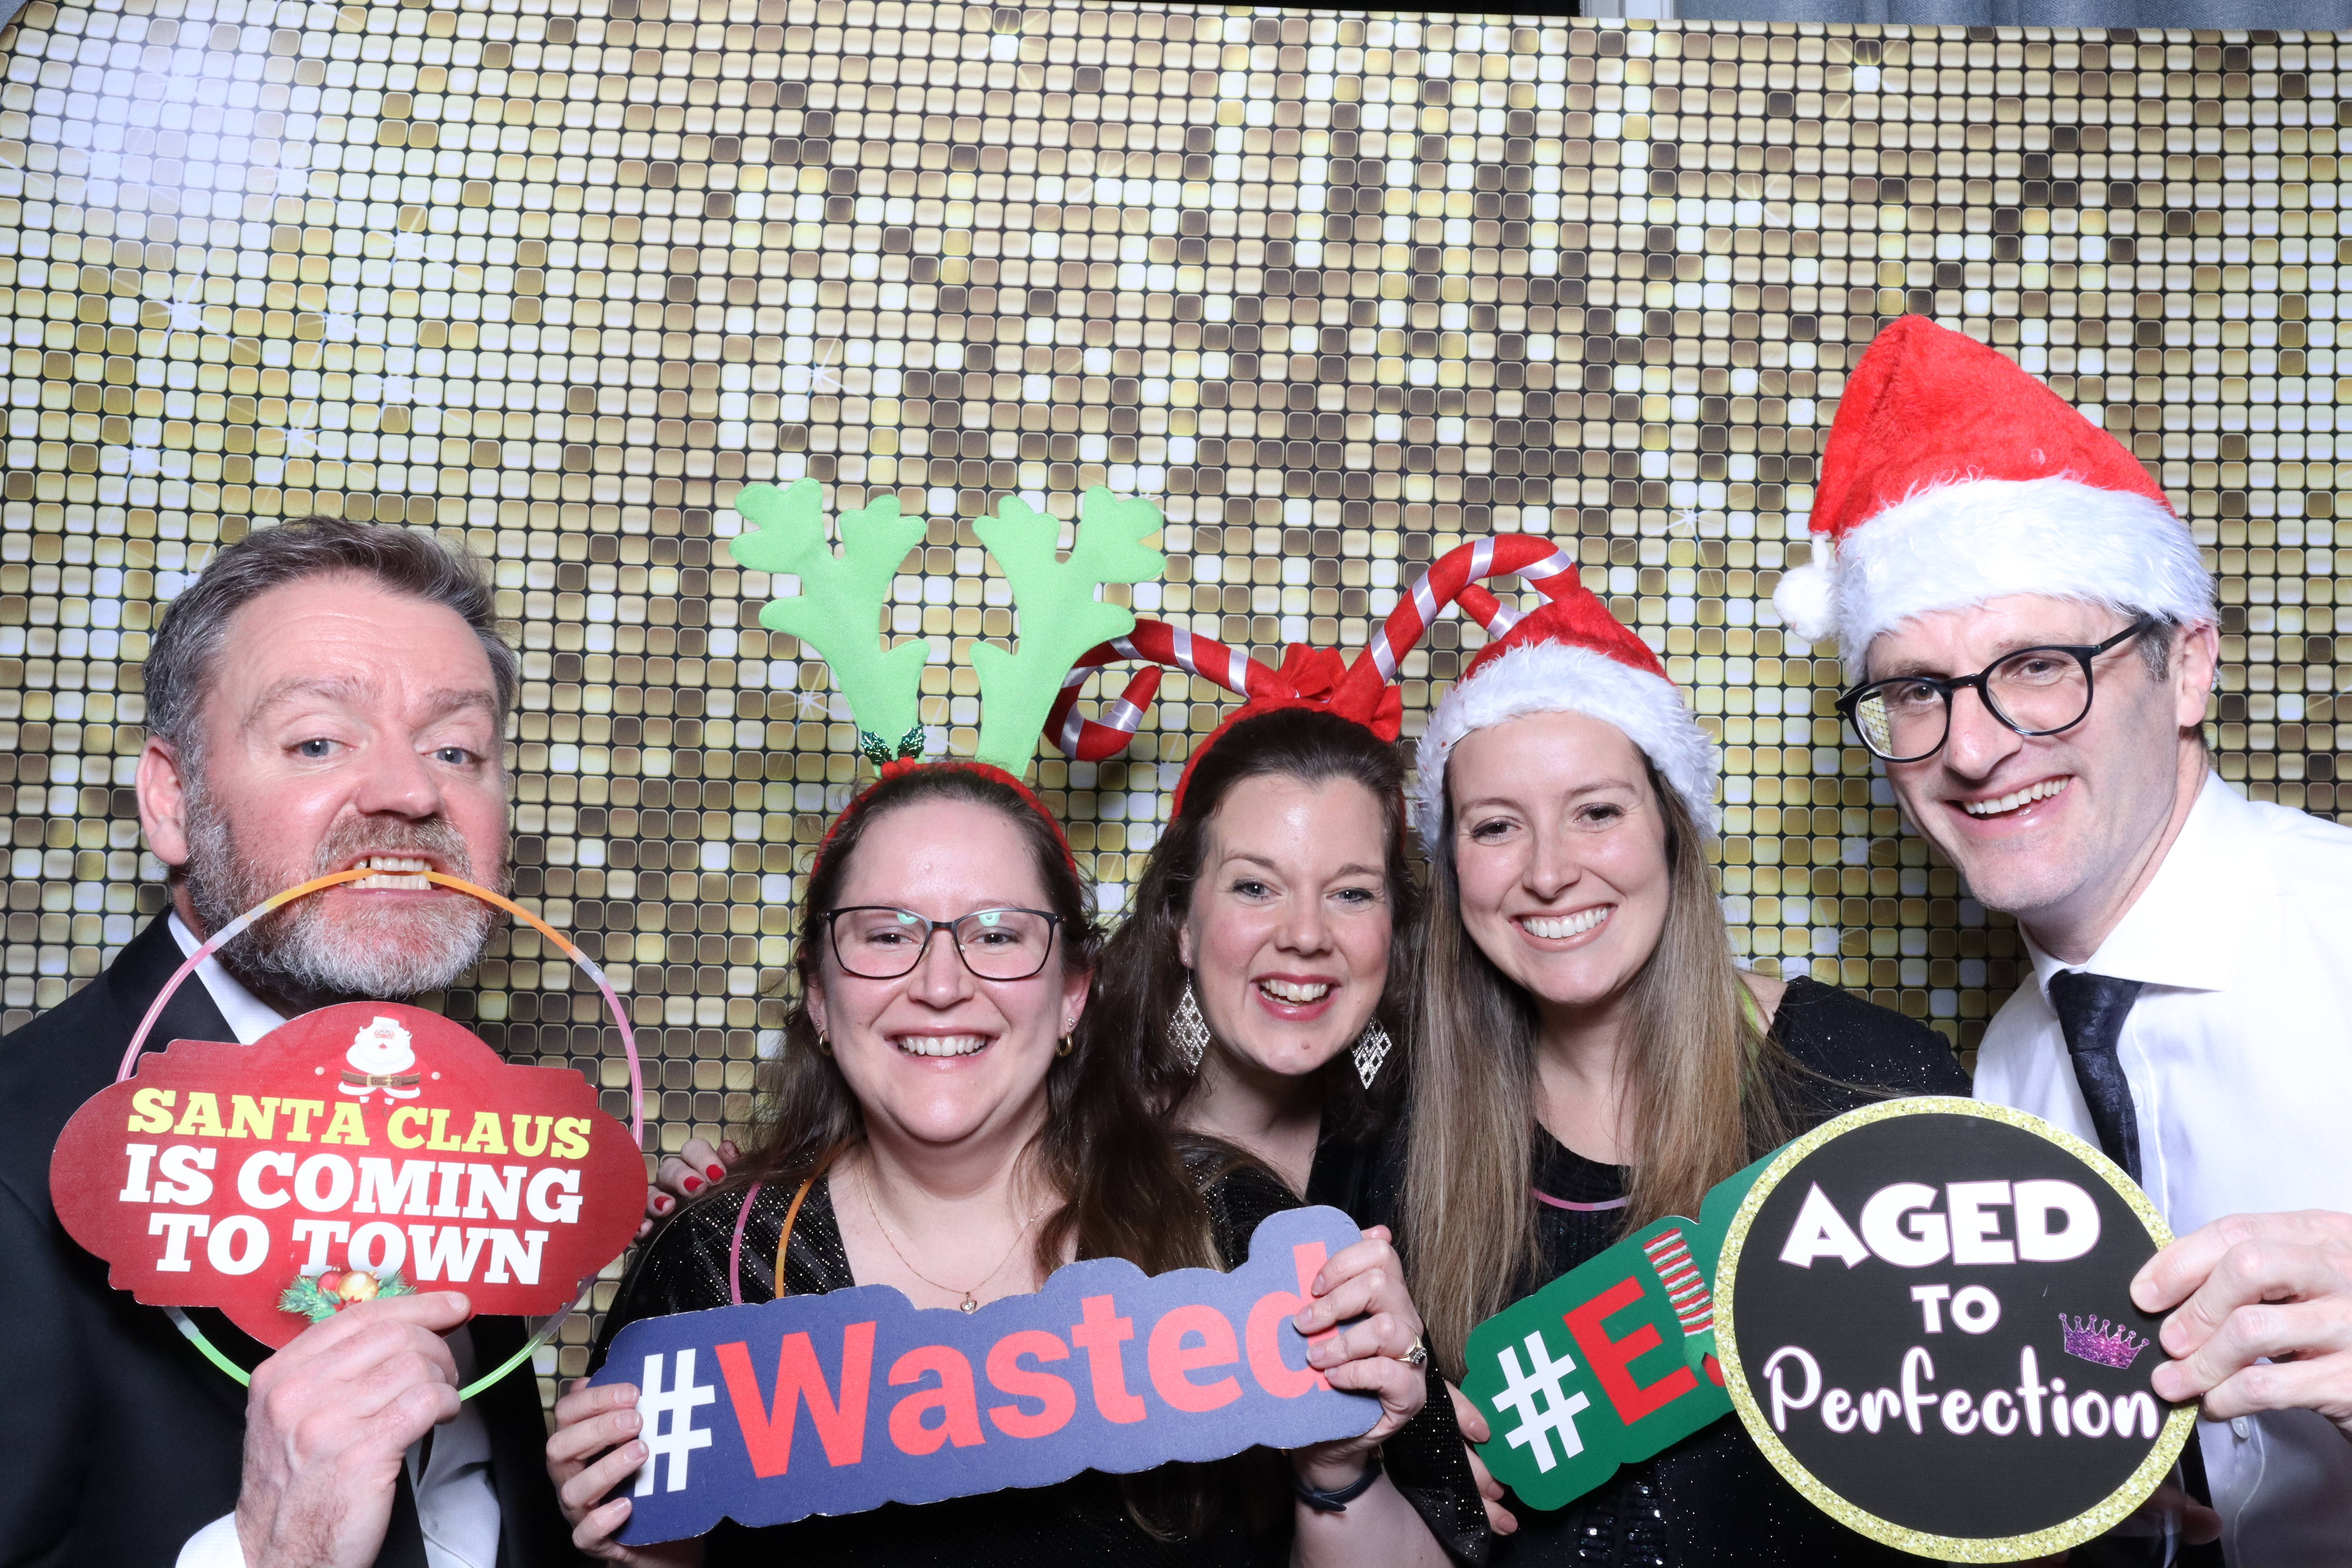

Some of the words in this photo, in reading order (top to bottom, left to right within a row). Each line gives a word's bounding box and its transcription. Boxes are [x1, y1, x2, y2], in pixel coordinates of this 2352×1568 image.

[127, 1087, 370, 1146] SANTA
[387, 1106, 591, 1160] CLAUS
[119, 1143, 217, 1204] IS
[237, 1150, 584, 1224] COMING
[1778, 1179, 2102, 1269] AGED
[148, 1212, 270, 1276] TO
[292, 1219, 549, 1285] TOWN
[1910, 1283, 2001, 1335] TO
[634, 1241, 1339, 1498] #Wasted
[1762, 1345, 2159, 1439] Perfection
